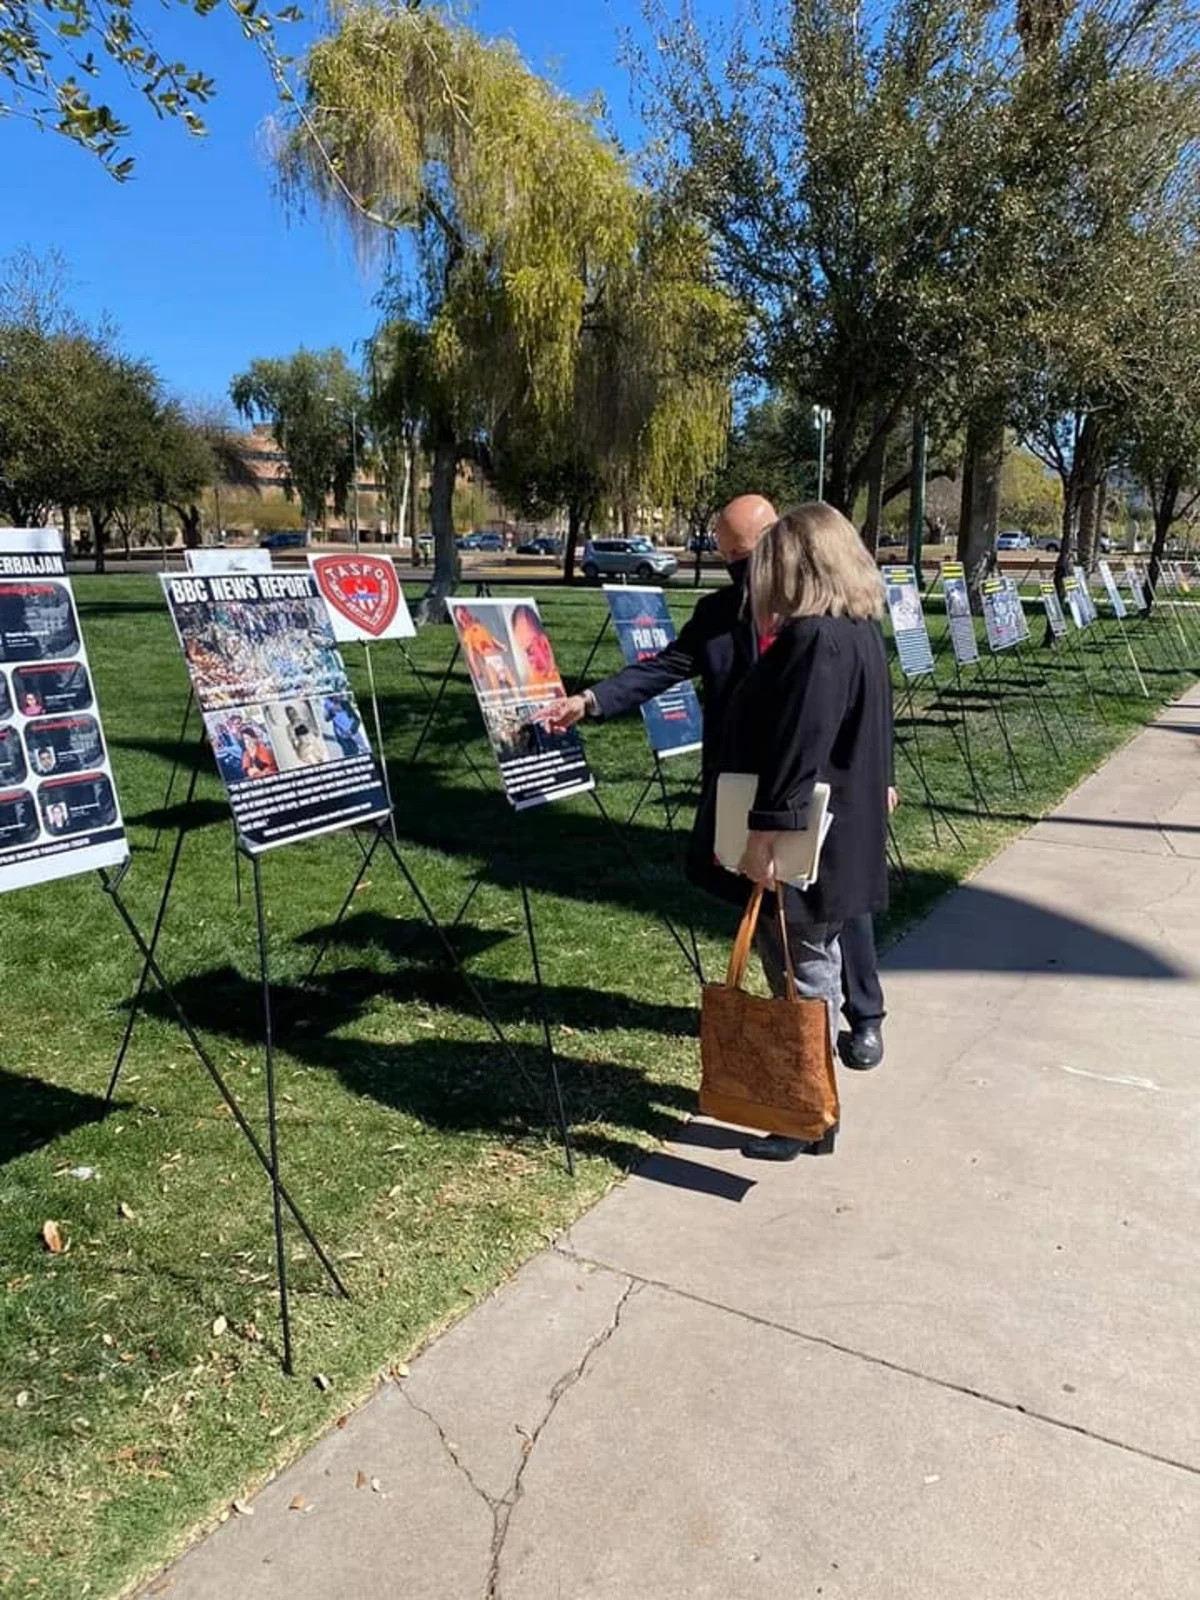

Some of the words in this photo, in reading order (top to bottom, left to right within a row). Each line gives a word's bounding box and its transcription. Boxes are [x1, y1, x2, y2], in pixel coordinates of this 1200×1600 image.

[171, 579, 208, 604] BBC
[209, 576, 258, 601] NEWS
[258, 575, 313, 598] REPORT
